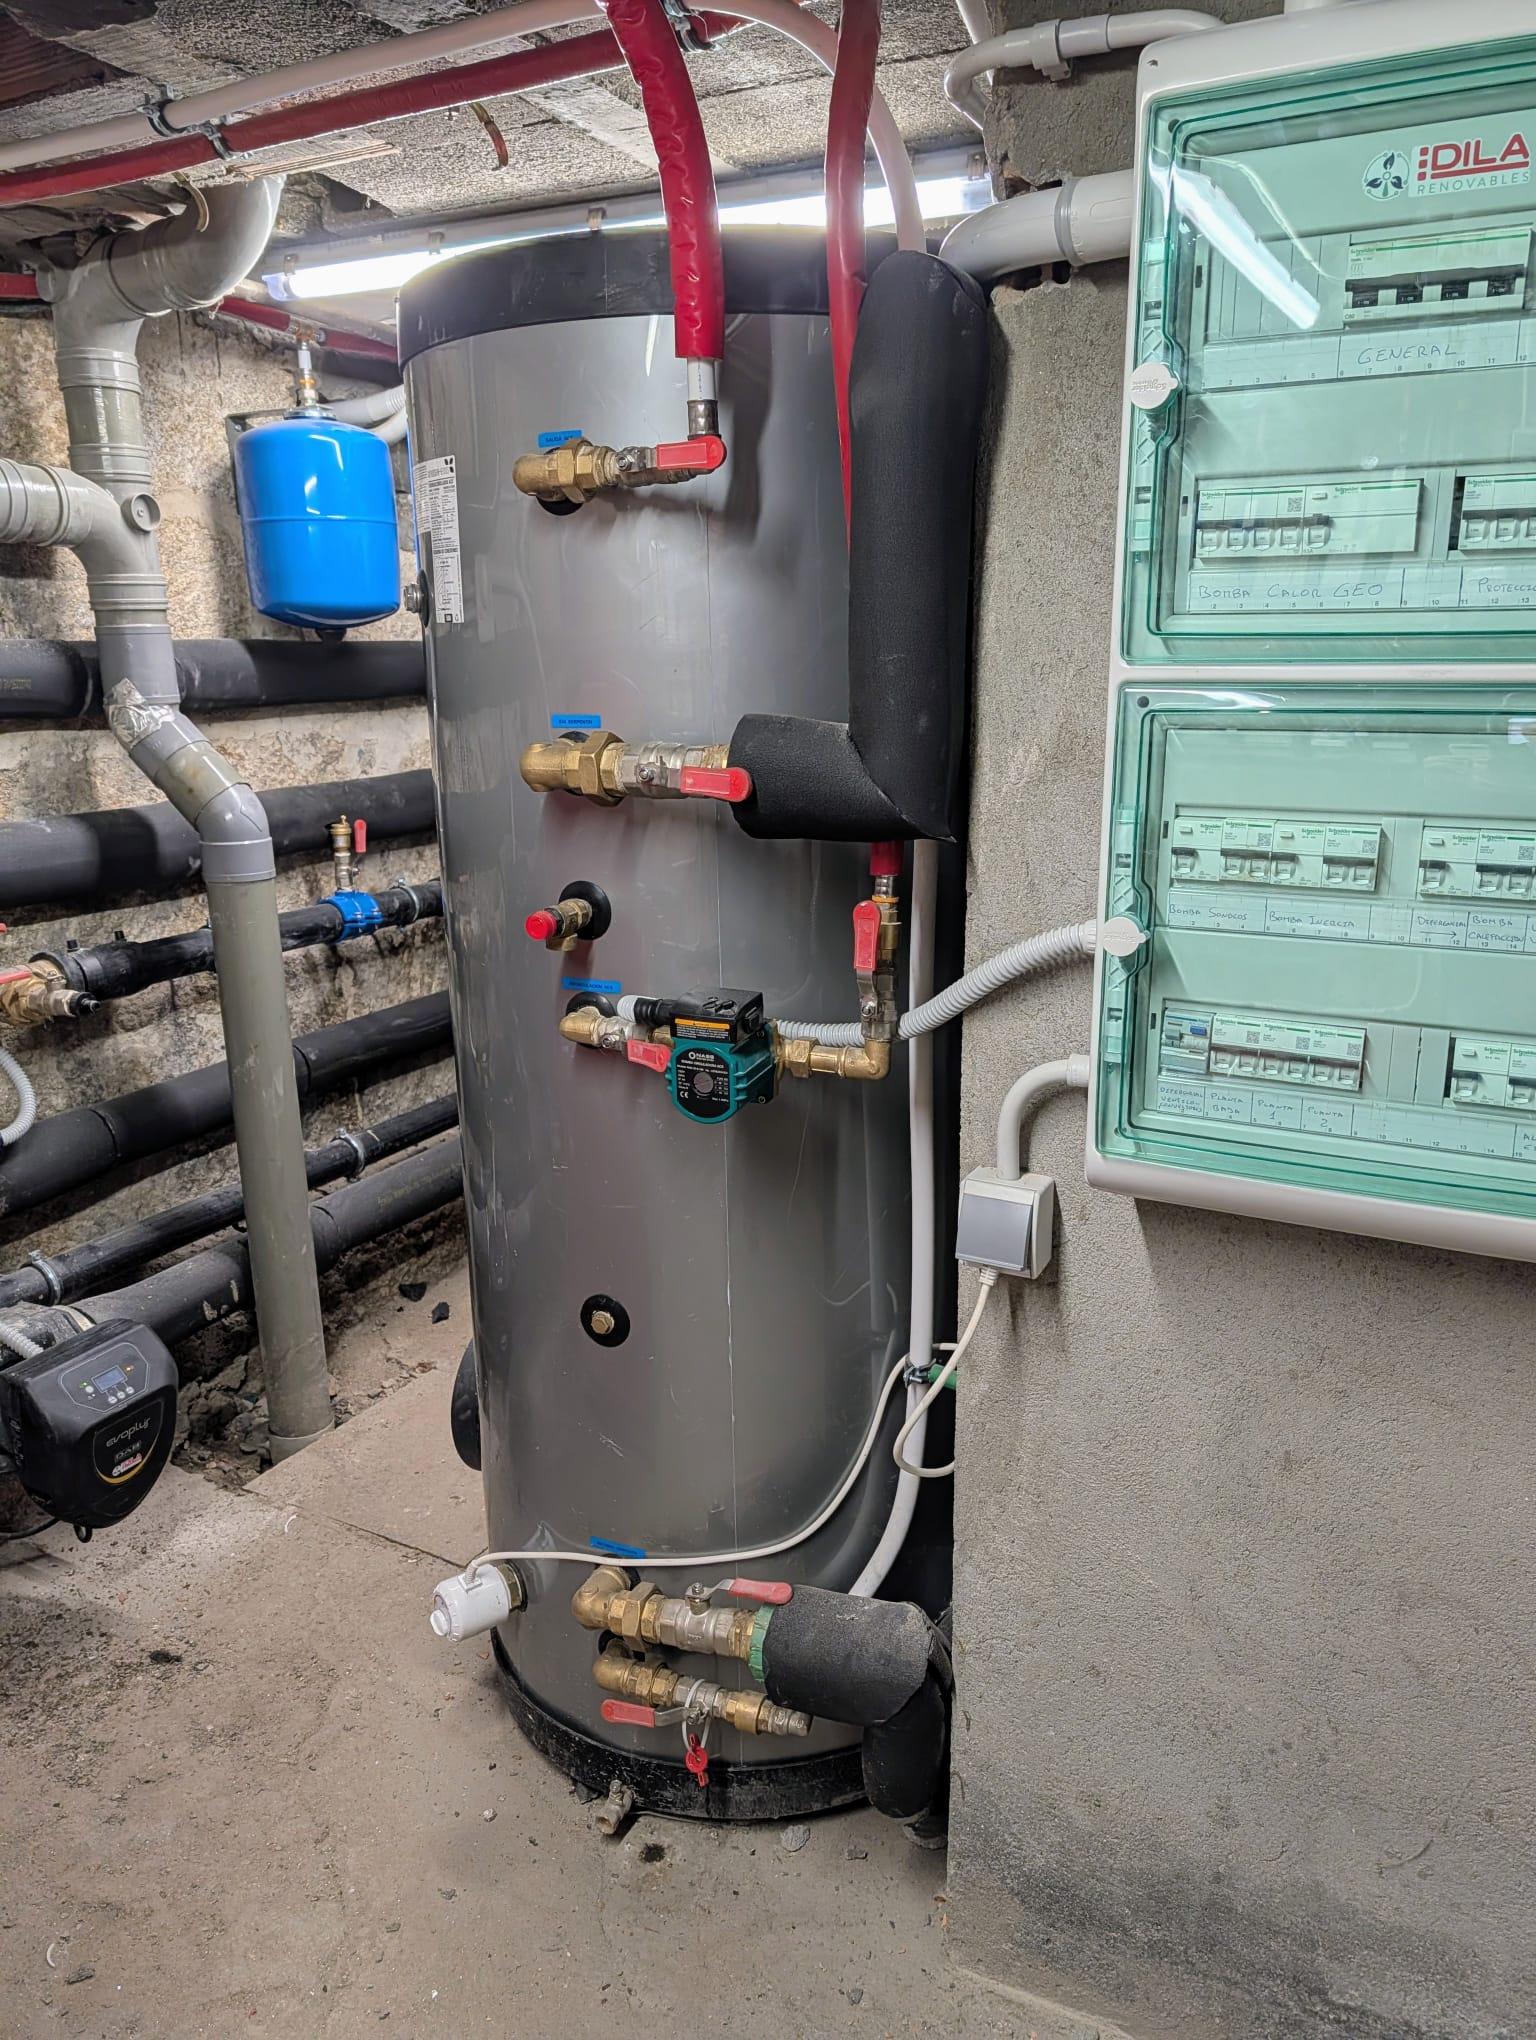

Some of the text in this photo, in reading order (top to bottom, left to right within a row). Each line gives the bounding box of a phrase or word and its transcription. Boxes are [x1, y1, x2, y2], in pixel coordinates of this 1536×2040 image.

[1417, 170, 1530, 195] RENOVABLES
[1357, 344, 1457, 365] GENERAL
[1199, 582, 1383, 598] BOMBA CALOR GEO
[1169, 903, 1201, 915] BOMBA
[1269, 911, 1303, 923] BOMBA
[1210, 1092, 1244, 1103] PLANTA
[1257, 1099, 1293, 1111] PLANTA
[1269, 1110, 1276, 1119] 1
[1307, 1106, 1343, 1117] PLANTA
[1320, 1118, 1328, 1127] 2
